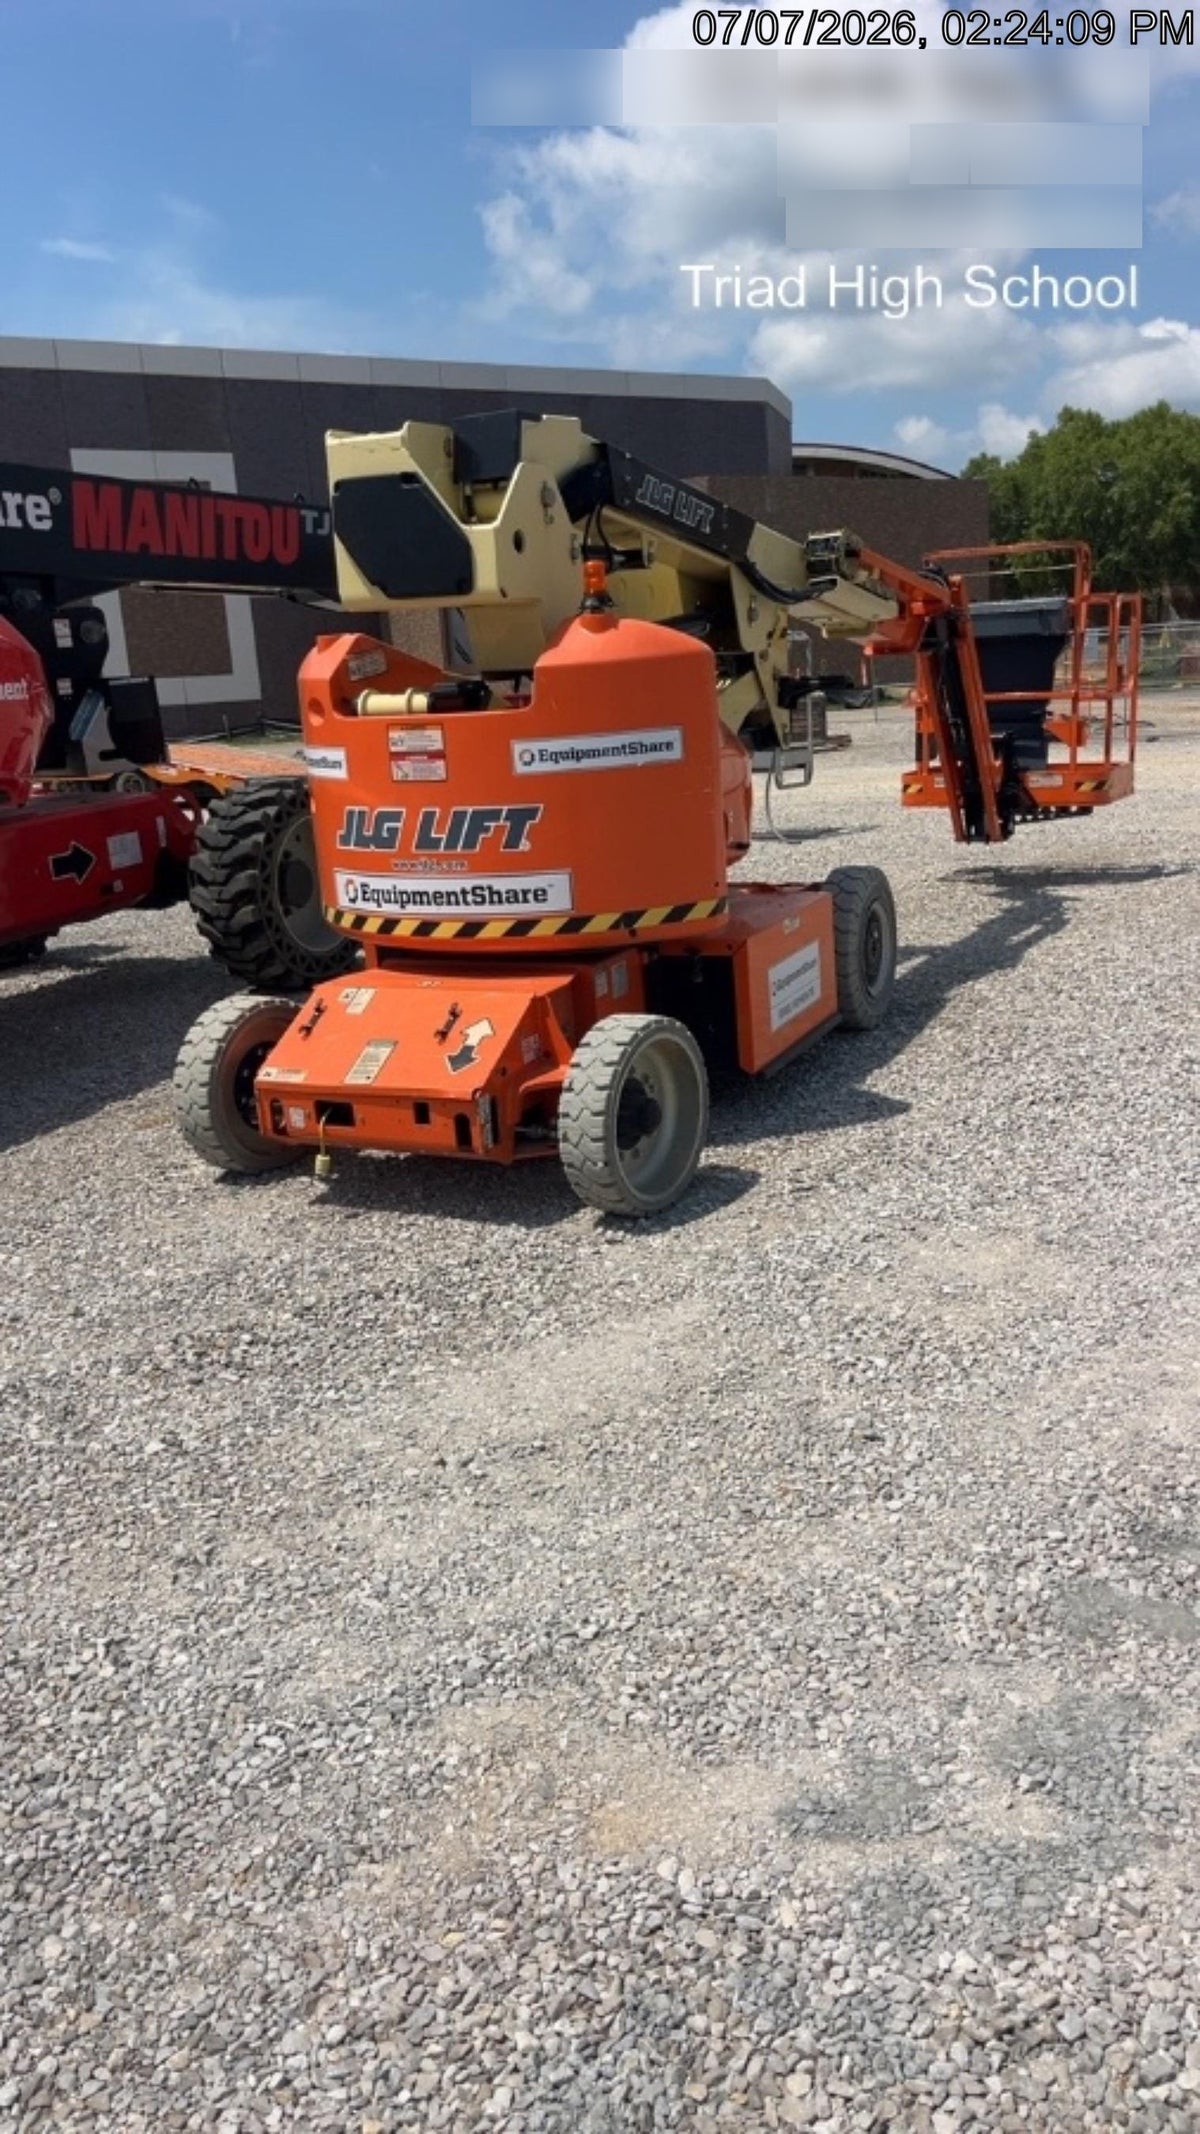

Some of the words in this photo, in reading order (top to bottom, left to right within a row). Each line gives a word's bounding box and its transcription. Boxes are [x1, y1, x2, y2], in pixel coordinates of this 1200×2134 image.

[72, 479, 301, 566] MANITOU
[635, 474, 676, 516] JLG
[673, 490, 715, 534] LIFT
[538, 740, 675, 765] EquipmentShare
[336, 806, 406, 851] JLG
[412, 803, 544, 854] LIFT
[360, 882, 549, 909] EquipmentShare
